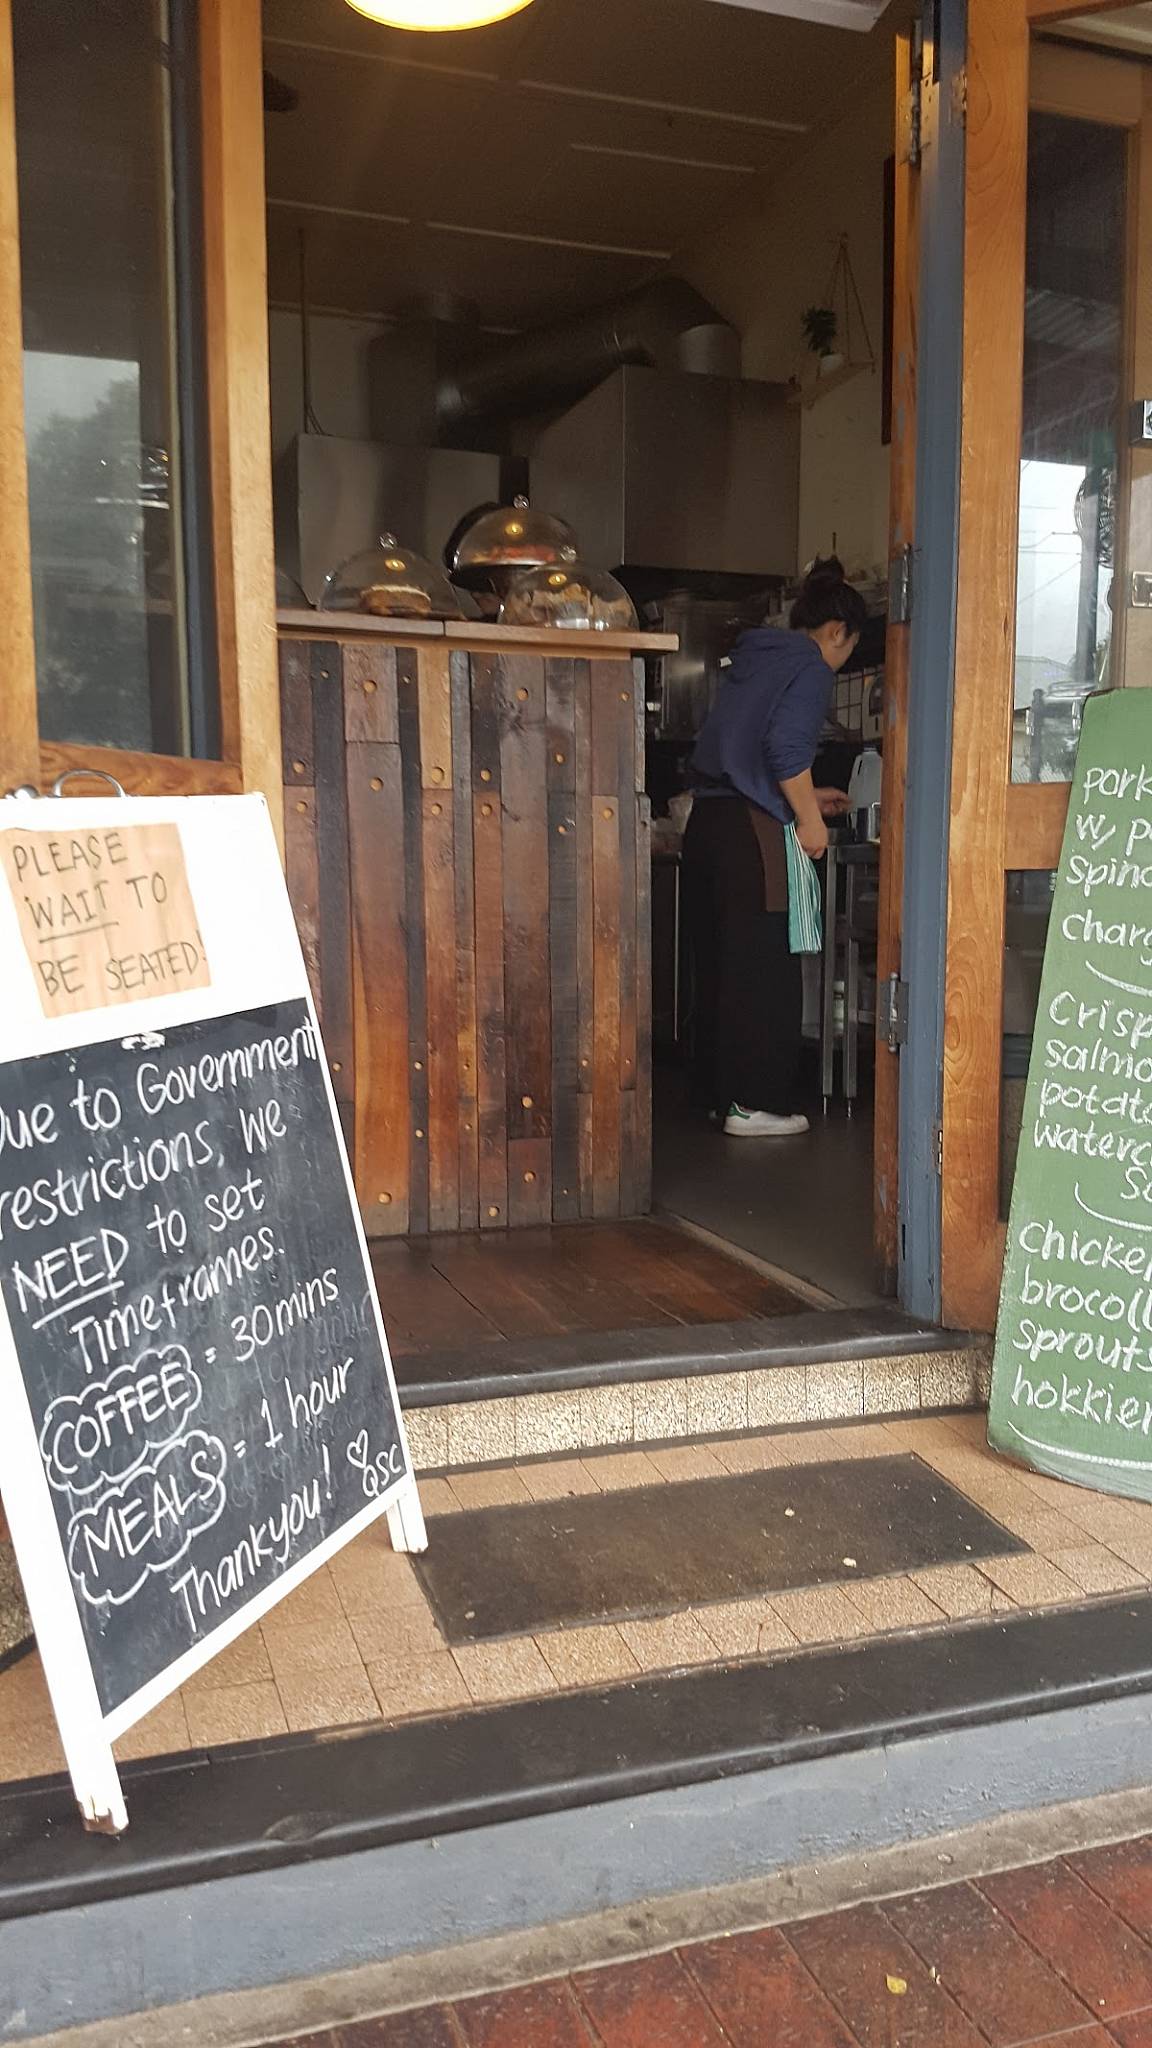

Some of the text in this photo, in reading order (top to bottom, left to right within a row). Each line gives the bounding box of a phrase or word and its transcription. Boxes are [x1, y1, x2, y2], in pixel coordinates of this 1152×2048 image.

[12, 831, 128, 882] PLEASE
[24, 871, 168, 929] WAIT TO
[37, 929, 208, 996] BE SEATED!
[0, 1016, 317, 1154] ue to Government
[12, 1168, 265, 1313] NEED to set
[54, 1361, 190, 1474] COFFEE
[82, 1450, 219, 1577] MEALS
[260, 1398, 283, 1448] 1
[284, 1356, 354, 1428] hour
